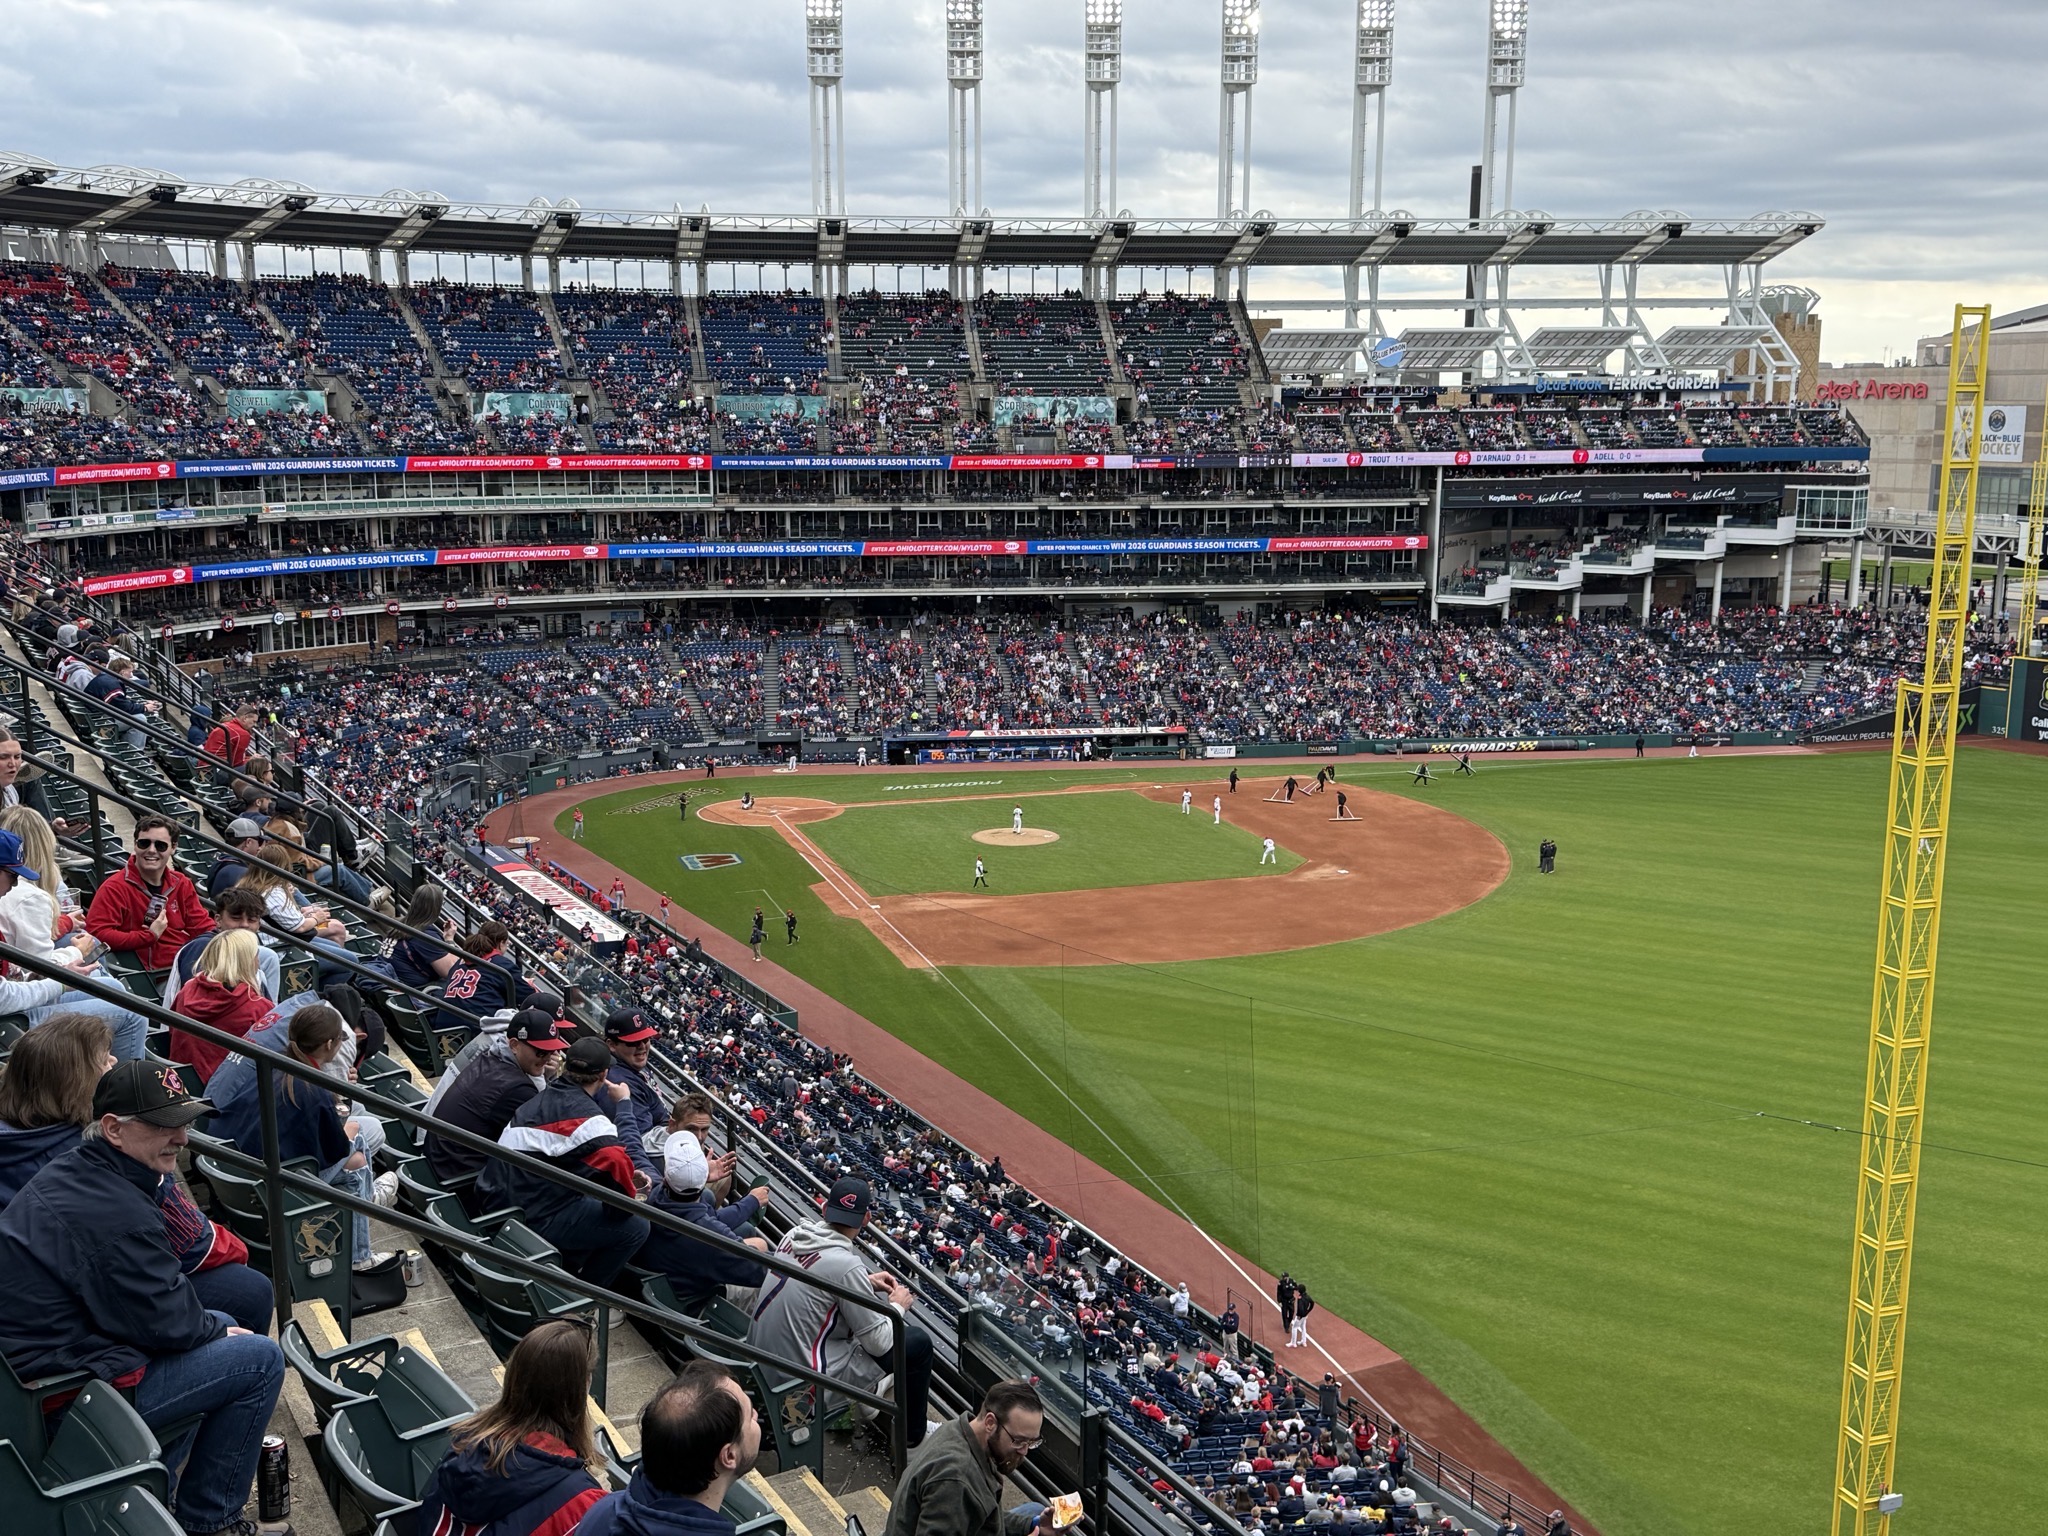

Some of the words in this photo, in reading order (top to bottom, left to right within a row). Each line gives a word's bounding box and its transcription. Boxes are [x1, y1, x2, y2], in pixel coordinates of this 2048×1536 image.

[1371, 348, 1388, 361] BLUE
[1389, 343, 1406, 354] MOON
[1535, 378, 1566, 393] BLUE
[1568, 379, 1602, 391] MOON
[1608, 377, 1663, 390] TERRACE
[1666, 376, 1720, 390] GARDEN
[1816, 379, 1859, 400] cket
[1863, 378, 1929, 400] Arena
[234, 395, 271, 407] SEWELL
[528, 398, 569, 409] COLAVITO
[1980, 434, 1998, 442] LACK
[2002, 434, 2021, 443] BLUE
[1349, 455, 1360, 465] 27
[1368, 455, 1390, 463] TROUT
[1457, 453, 1468, 462] 25
[1476, 453, 1511, 462] D'ARNAUD
[1578, 452, 1584, 461] 7
[1593, 452, 1615, 461] ADELL
[1619, 452, 1631, 461] 0-0
[252, 462, 266, 470] WIN
[267, 462, 286, 470] 2026
[286, 461, 331, 469] GUARDIANS
[333, 460, 360, 468] SEASON
[361, 459, 399, 468] TICKETS.
[440, 458, 534, 467] OHIOLOTTERY.COM/MYLOTTO
[584, 459, 680, 467] OHIOLOTTERY.COM/MYLOTTO
[795, 458, 810, 466] WIN
[811, 458, 830, 466] 2026
[832, 458, 876, 466] GUARDIANS
[877, 458, 906, 466] SEASON
[911, 458, 943, 466] TICKETS.
[982, 458, 1073, 466] OHIOLOTTERY.COM/MYLOTTO
[7, 475, 25, 484] SEASON
[1488, 494, 1517, 502] KeyBank
[1532, 491, 1559, 504] North
[1558, 489, 1582, 500] Coast
[1643, 492, 1672, 500] KeyBank
[1686, 489, 1713, 502] North
[1712, 487, 1736, 498] Coast
[696, 545, 714, 553] WIN
[715, 545, 735, 553] 2026
[737, 545, 784, 553] GUARDIANS
[785, 544, 818, 552] SEASON
[819, 544, 856, 552] TICKETS.
[896, 544, 992, 552] OHIOLOTTERY.COM/MYLOTTO
[1110, 542, 1126, 550] WIN
[1127, 542, 1146, 550] 2026
[1147, 541, 1192, 549] GUARDIANS
[1194, 541, 1224, 549] SEASON
[1300, 539, 1393, 548] OHIOLOTTERY.COM/MYLOTTO
[470, 549, 571, 560] OHIOLOTTERY.COM/MYLOTTO
[272, 562, 288, 571] WIN
[289, 561, 308, 569] 2026
[309, 558, 356, 568] GUARDIANS
[358, 556, 389, 565] SEASON
[391, 554, 428, 563] TICKETS.
[88, 575, 167, 592] OHIOLOTTERY.COM/MYLOTTO
[332, 609, 341, 617] 21
[224, 620, 233, 628] 14
[1991, 725, 2005, 735] 325
[1811, 733, 1858, 743] TECHNICALLY,
[1859, 731, 1886, 740] PEOPLE
[1450, 742, 1517, 753] CONRAD'S
[882, 780, 1004, 791] PROGRESSIVE
[444, 968, 481, 999] 23
[155, 1070, 164, 1079] 2
[167, 1089, 175, 1099] 2
[840, 1193, 857, 1209] C
